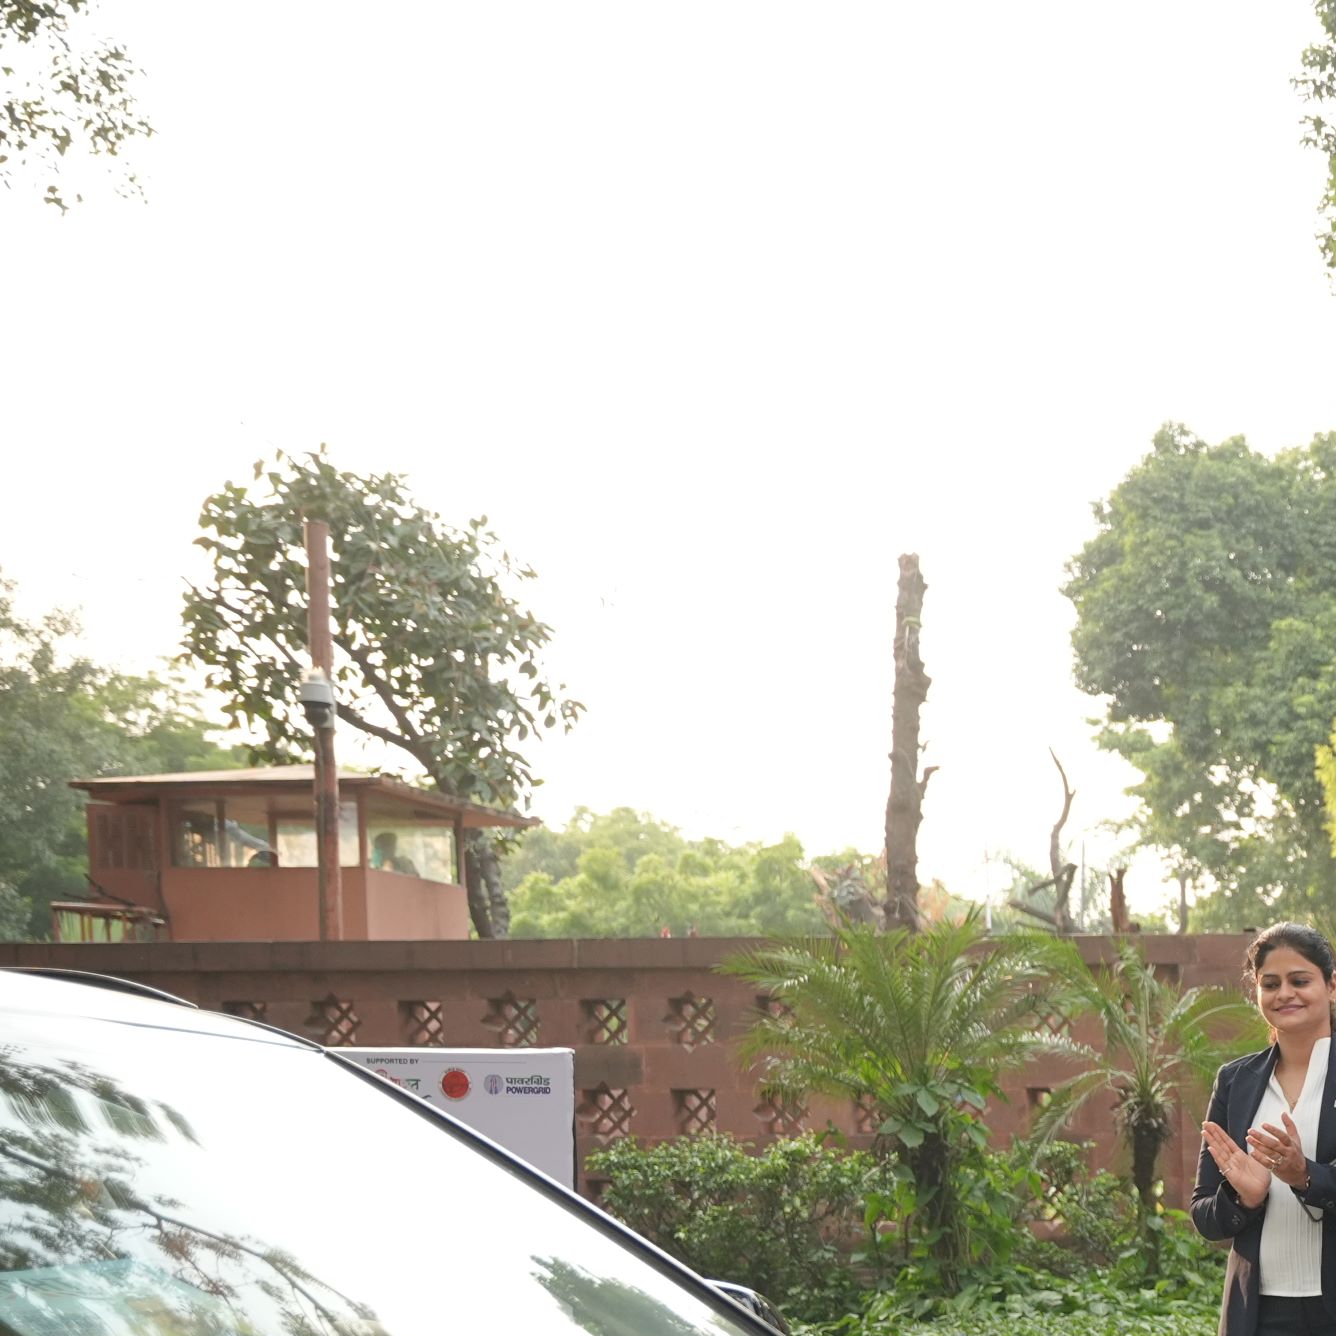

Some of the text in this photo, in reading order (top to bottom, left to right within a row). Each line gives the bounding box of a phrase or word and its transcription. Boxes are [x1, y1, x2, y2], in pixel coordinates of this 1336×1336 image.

[366, 1057, 409, 1065] SUPPORTED
[506, 1075, 551, 1086] पावरग्रिड
[506, 1086, 551, 1095] POWERGRID
